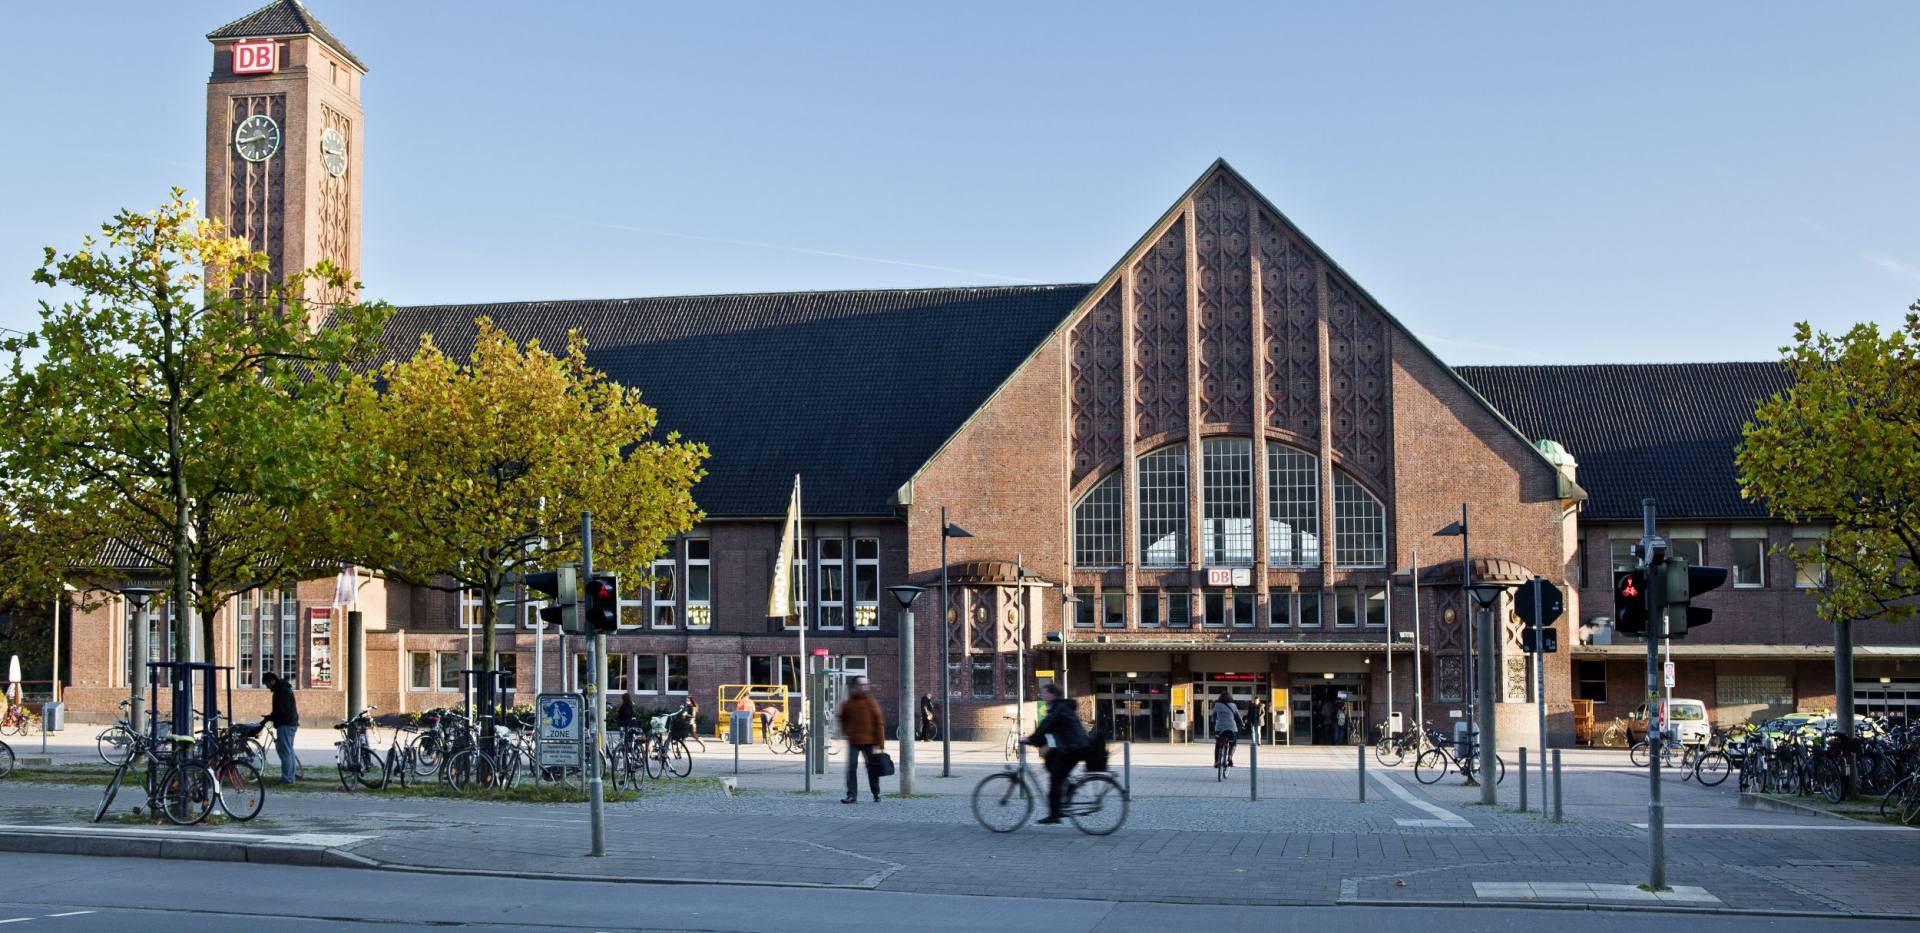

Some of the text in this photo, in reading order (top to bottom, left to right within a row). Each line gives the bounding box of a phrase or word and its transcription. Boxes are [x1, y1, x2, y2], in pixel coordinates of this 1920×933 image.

[239, 46, 271, 68] DB
[1211, 571, 1229, 583] DB
[550, 730, 570, 738] ZONE
